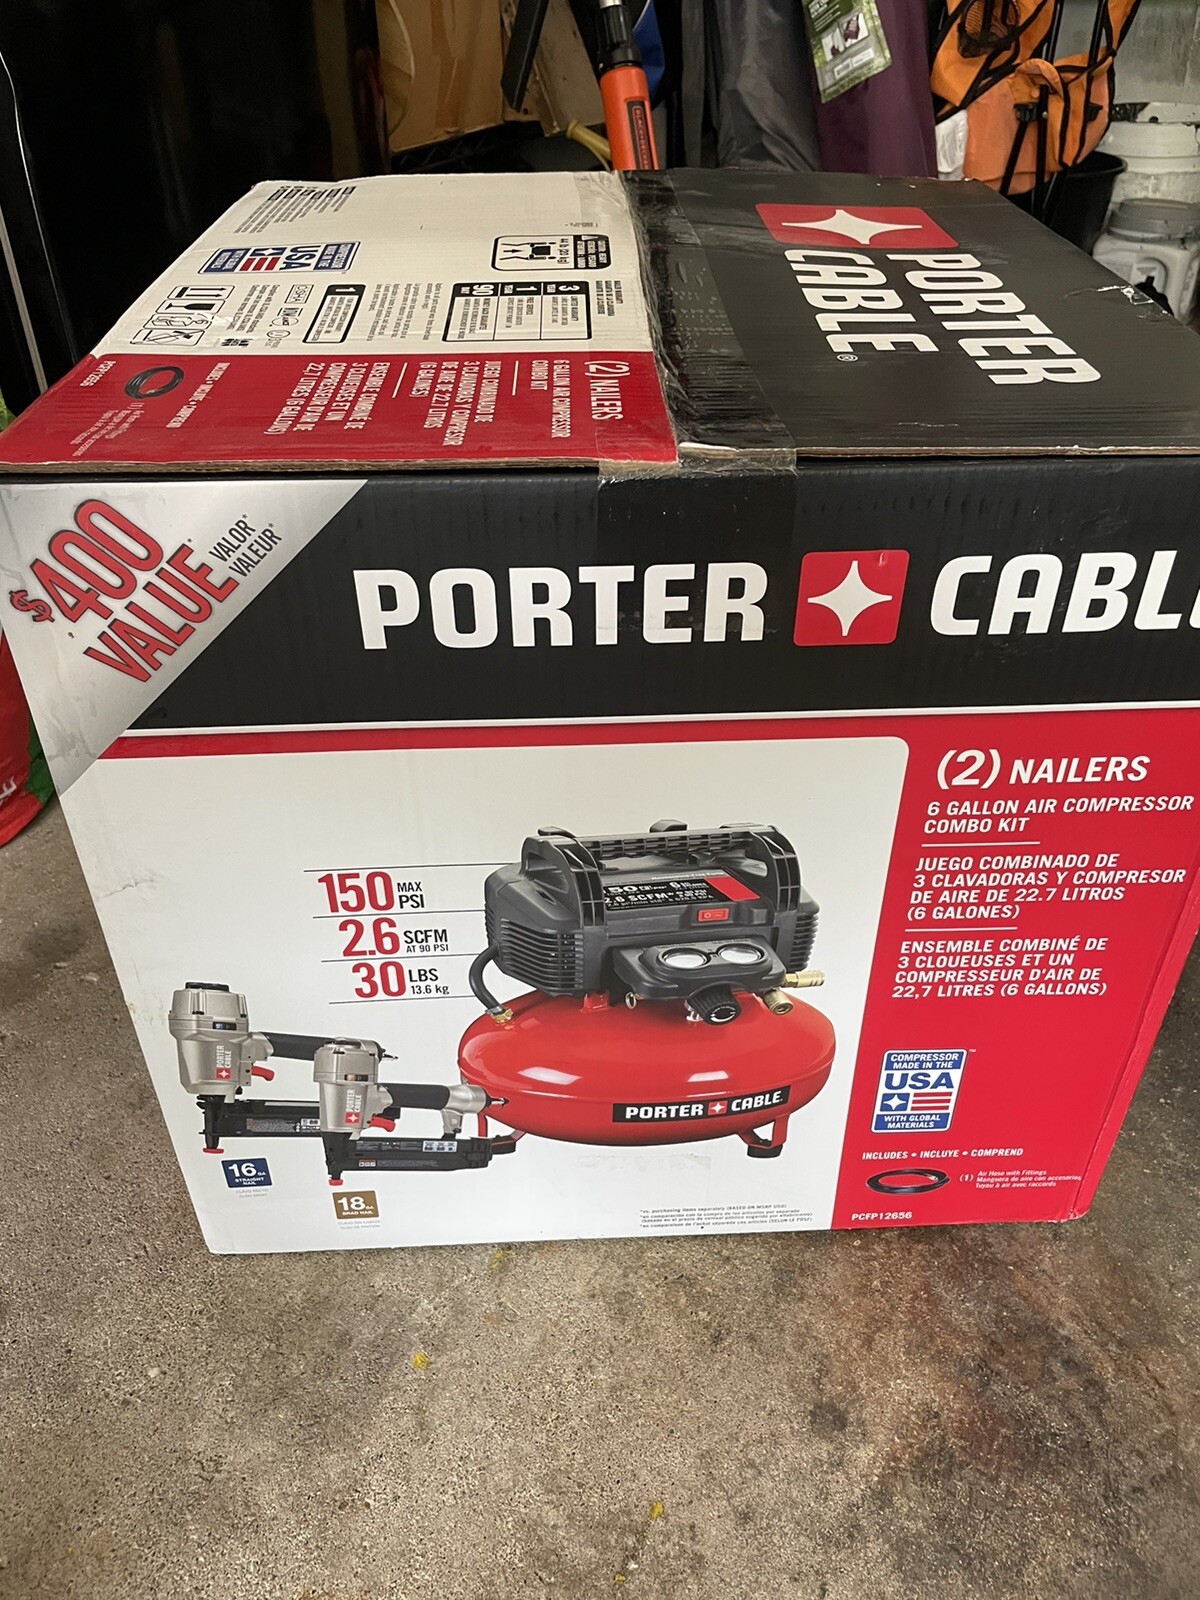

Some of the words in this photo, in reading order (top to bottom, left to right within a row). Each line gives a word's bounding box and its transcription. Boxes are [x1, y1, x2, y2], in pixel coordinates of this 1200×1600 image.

[275, 245, 323, 270] USA
[471, 284, 494, 295] 90
[886, 254, 1101, 385] PORTER
[584, 360, 630, 377] (2)
[589, 379, 622, 419] NAILERS
[8, 498, 164, 623] $400
[353, 561, 768, 651] PORTER
[929, 549, 1200, 637] CABL
[937, 749, 1001, 790] (2)
[1009, 755, 1151, 785] NAILERS
[927, 801, 940, 816] 6
[946, 799, 1019, 816] GALLON
[1024, 799, 1058, 814] AIR
[1062, 795, 1195, 813] COMPRESSOR
[924, 818, 992, 834] COMBO
[998, 817, 1030, 832] KIT
[915, 857, 974, 872] JUEGO
[978, 854, 1090, 871] COMBINADO
[1094, 853, 1120, 868] DE
[913, 874, 926, 888] 3
[931, 872, 1049, 888] CLAVADORAS
[1055, 871, 1070, 885] Y
[1072, 869, 1186, 885] COMPRESOR
[318, 871, 395, 913] 150
[397, 882, 423, 893] MAX
[910, 890, 932, 905] DE
[938, 889, 979, 904] AIRE
[985, 889, 1009, 903] DE
[1014, 888, 1057, 902] 22.7
[1061, 886, 1126, 901] LITROS
[398, 894, 425, 909] PSI
[907, 907, 926, 922] (6
[931, 905, 1021, 921] GALONES)
[339, 917, 400, 957] 2.6
[403, 929, 448, 944] SCFM
[900, 939, 994, 954] ENSEMBLE
[998, 935, 1081, 952] COMBINÉ
[1084, 937, 1108, 951] DE
[406, 945, 416, 953] AT
[419, 945, 430, 953] 90
[433, 944, 449, 952] PSI
[897, 957, 909, 969] 3
[914, 954, 1016, 969] CLOUEUSES
[1021, 954, 1044, 967] ET
[1048, 953, 1075, 966] UN
[352, 961, 406, 998] 30
[408, 968, 439, 982] LBS
[894, 969, 1024, 983] COMPRESSEUR
[1029, 968, 1074, 982] D'AIR
[1079, 967, 1102, 981] DE
[411, 985, 432, 995] 13.6
[435, 984, 449, 996] kg
[891, 985, 932, 999] 22,7
[937, 984, 995, 997] LITRES
[1000, 983, 1019, 997] (6
[1023, 982, 1107, 996] GALLONS)
[890, 1053, 960, 1062] COMPRESSOR
[893, 1061, 920, 1069] MADE
[922, 1061, 933, 1069] IN
[936, 1061, 954, 1069] THE
[884, 1072, 955, 1090] USA
[625, 1104, 704, 1119] PORTER
[731, 1090, 782, 1112] CABLE
[887, 1121, 934, 1129] MATERIALS
[909, 1114, 941, 1122] GLOBAL
[862, 1151, 908, 1160] INCLUDES
[919, 1150, 959, 1159] INCLUYE
[970, 1148, 1024, 1157] COMPREND
[959, 1174, 974, 1182] (1)
[851, 1211, 913, 1221] PCFP12656
